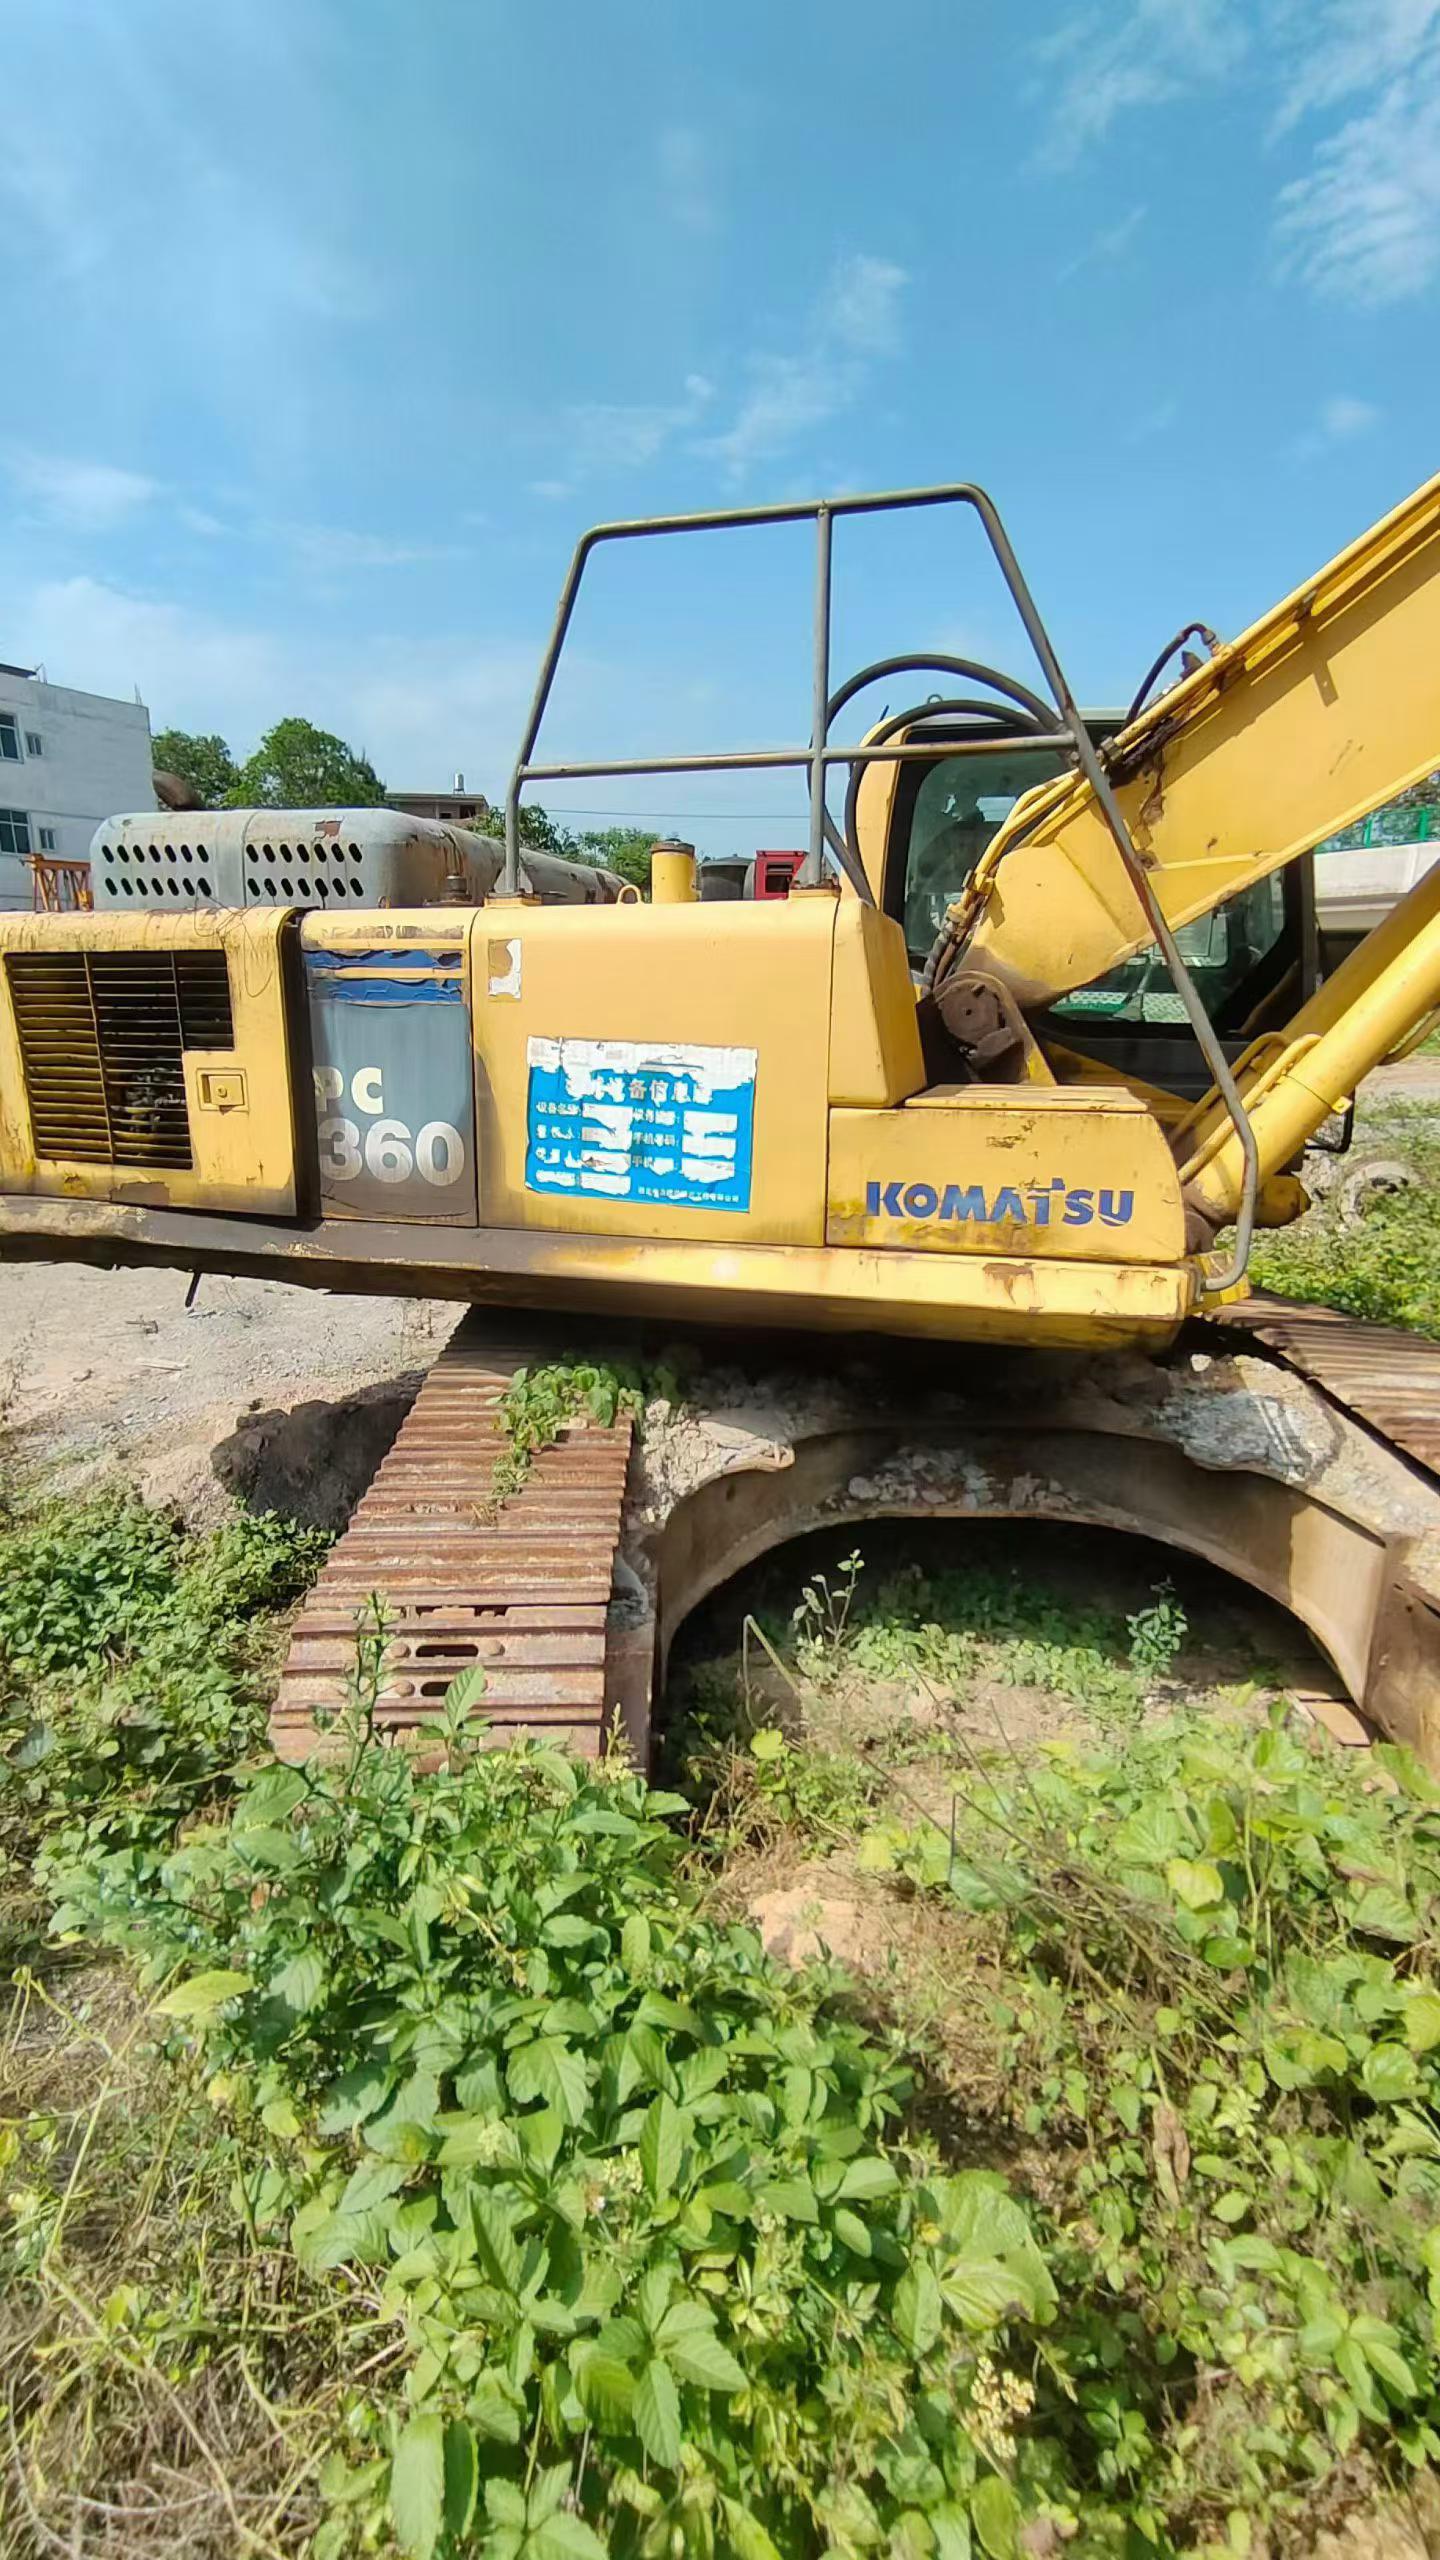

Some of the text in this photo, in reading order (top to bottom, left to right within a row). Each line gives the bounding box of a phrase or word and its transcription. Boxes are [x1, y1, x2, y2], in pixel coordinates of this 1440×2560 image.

[312, 1065, 384, 1115] PC
[318, 1118, 465, 1187] 360
[865, 1177, 1135, 1227] KOMATSU
